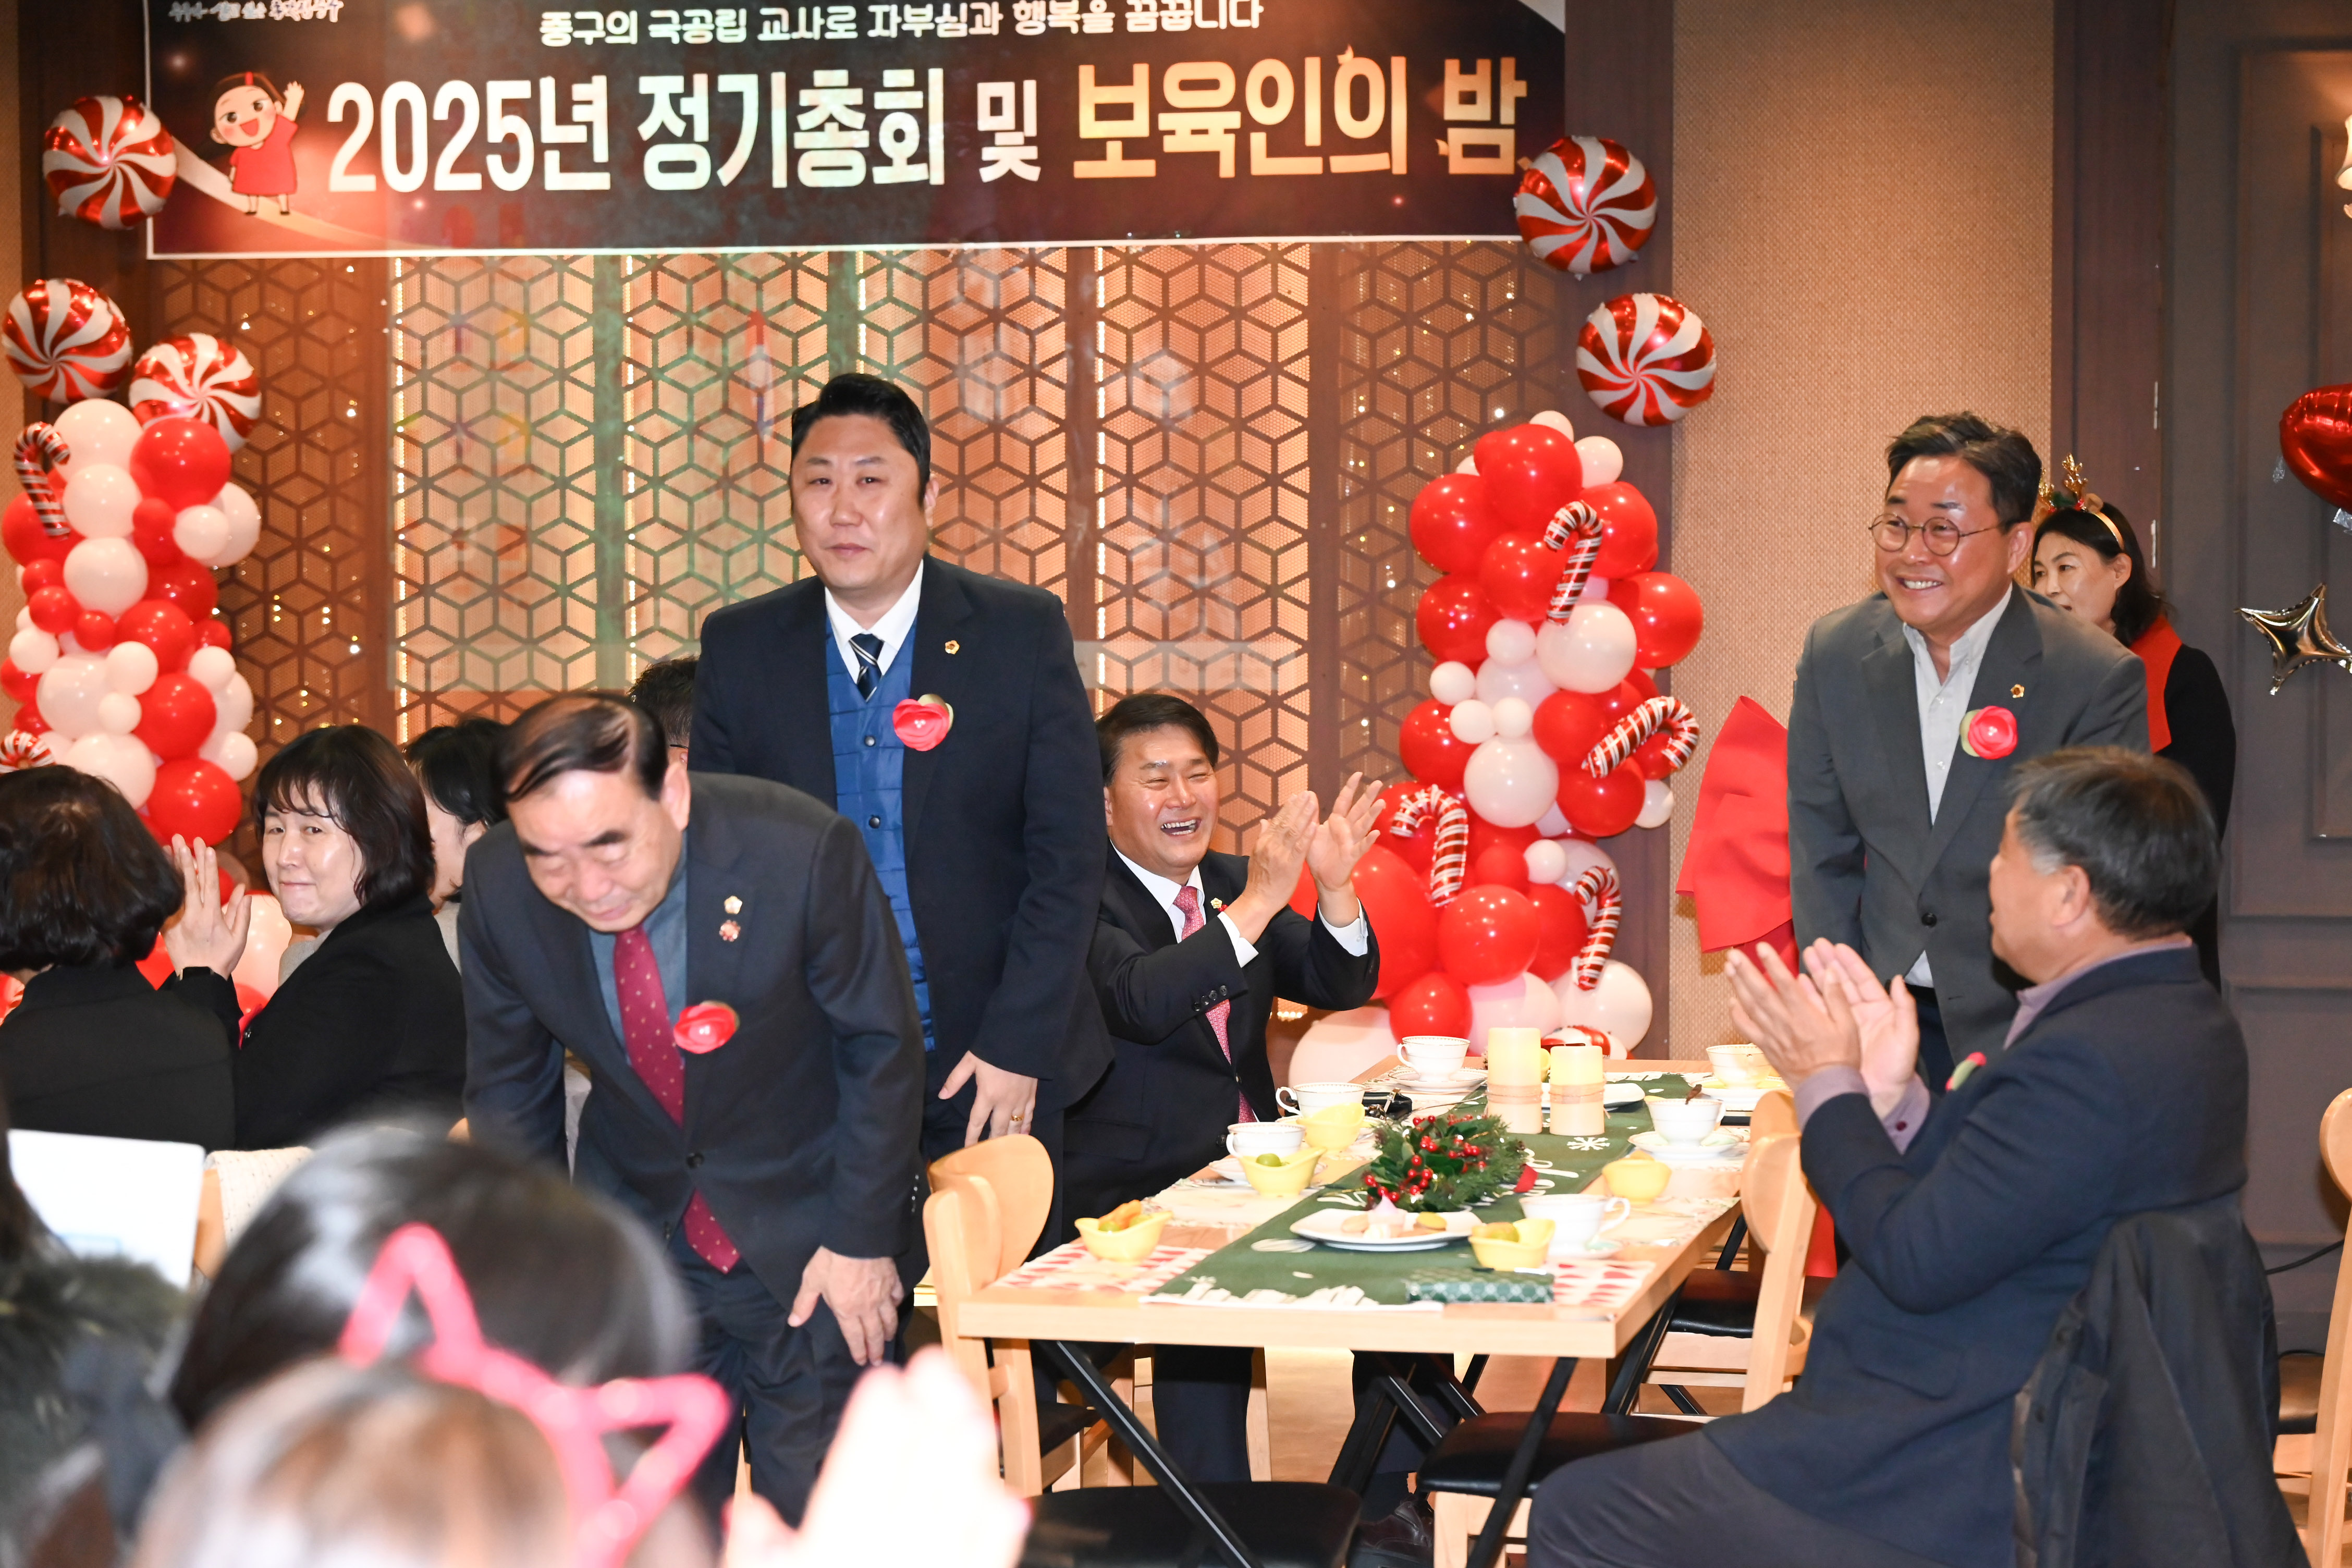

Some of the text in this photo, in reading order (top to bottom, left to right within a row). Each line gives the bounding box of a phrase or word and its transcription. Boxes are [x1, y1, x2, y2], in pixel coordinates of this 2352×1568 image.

[539, 0, 1264, 47] 중구의 국공립 교사로 자부심과 행복을 꿈꿉니다
[327, 54, 1528, 192] 2025년 정기총회 및 보육인의 밤
